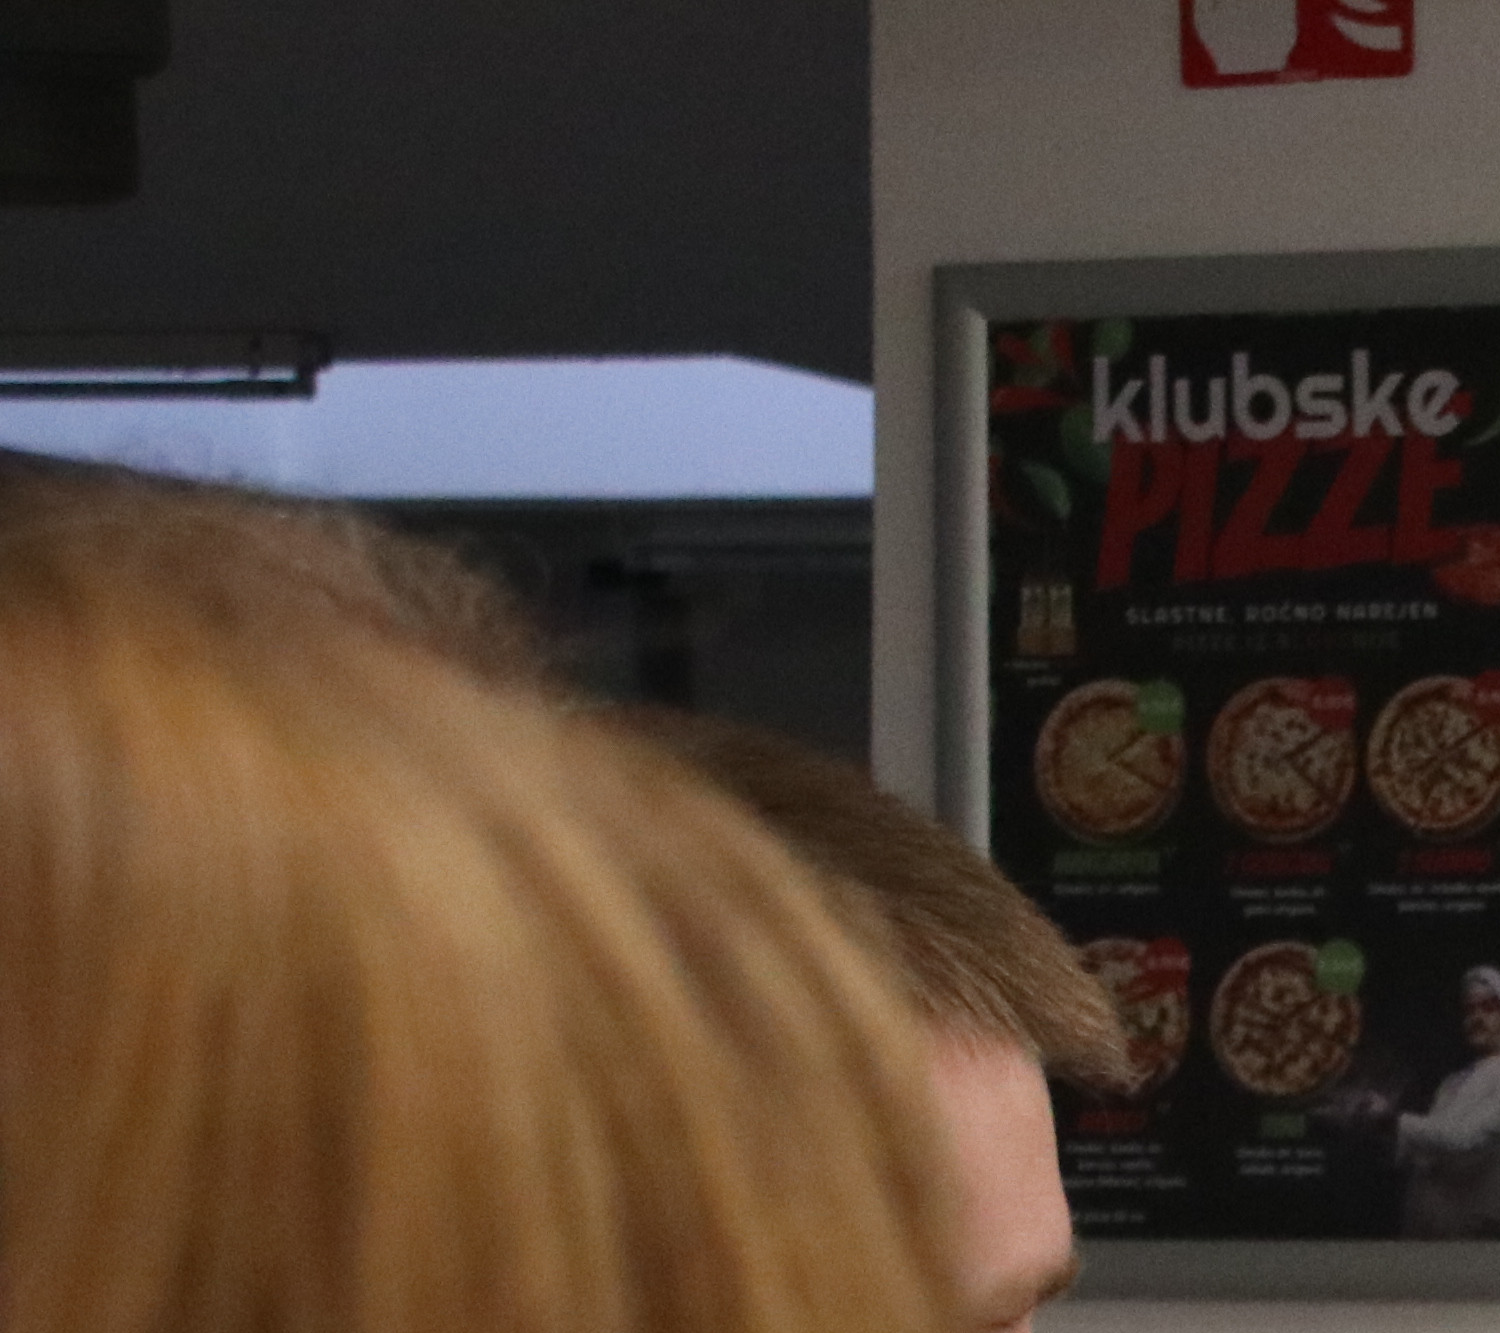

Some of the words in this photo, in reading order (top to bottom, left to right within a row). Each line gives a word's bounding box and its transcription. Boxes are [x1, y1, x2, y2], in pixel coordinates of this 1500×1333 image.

[1091, 348, 1465, 444] klubske
[1098, 435, 1468, 592] PIZZE
[1243, 599, 1330, 625] ROČNO
